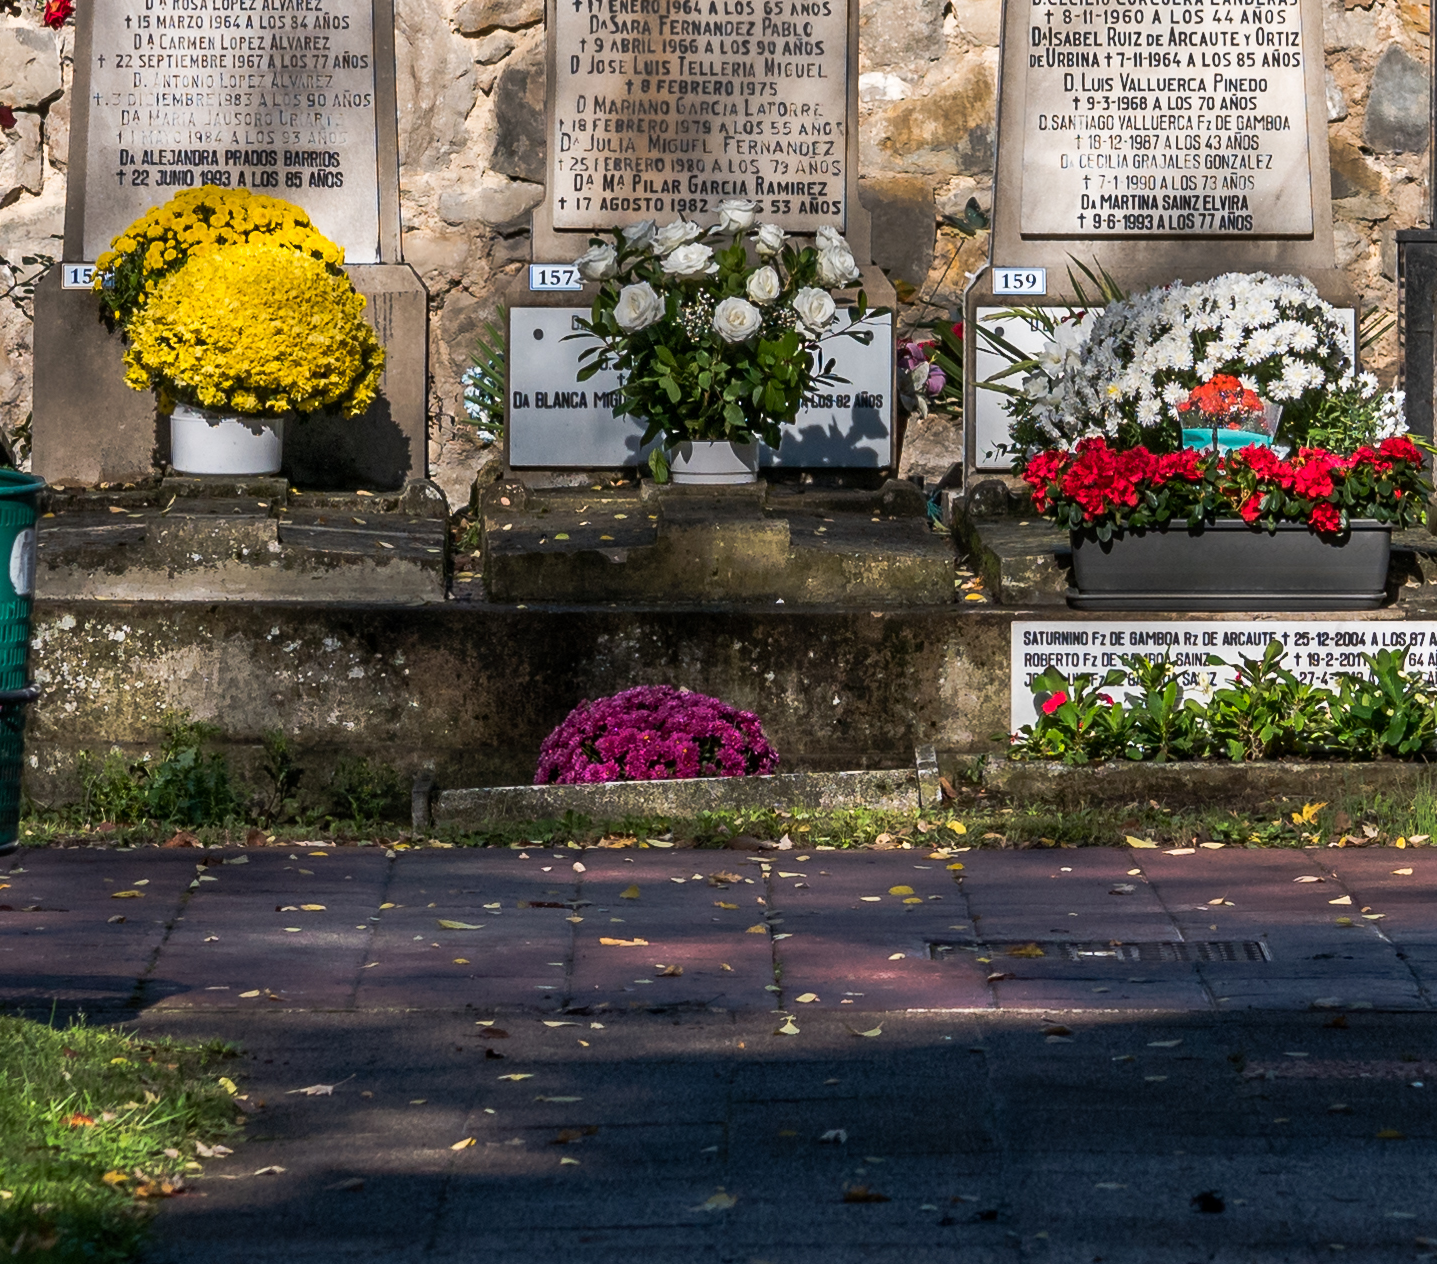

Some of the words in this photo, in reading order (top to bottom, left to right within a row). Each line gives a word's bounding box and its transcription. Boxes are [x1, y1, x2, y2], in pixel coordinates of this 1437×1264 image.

[138, 15, 150, 29] 15
[157, 15, 204, 29] MARZO
[210, 15, 241, 29] 1964
[260, 16, 286, 30] LOS
[291, 16, 308, 30] 84
[314, 16, 349, 30] AÑOS
[1171, 9, 1204, 24] LOS
[1213, 10, 1234, 24] 44
[1240, 6, 1286, 24] AÑOS
[610, 38, 656, 54] ABRIL
[662, 39, 698, 54] 1966
[720, 40, 750, 56] LOS
[757, 40, 776, 56] 90
[782, 38, 825, 56] AÑOS
[657, 80, 734, 97] FEBRERO
[740, 81, 778, 97] 1975
[142, 149, 219, 167] ALEJANDRA
[225, 150, 277, 167] PRADOS
[284, 151, 340, 168] BARRIOS
[1100, 194, 1159, 210] MARTINA
[1162, 195, 1200, 211] SAINZ
[1203, 195, 1248, 212] ELVIRA
[539, 270, 574, 286] 157
[1002, 274, 1037, 289] 159
[1024, 631, 1089, 646] SATURNINO
[1110, 632, 1125, 646] DE
[1129, 631, 1180, 647] GAMBOA
[1203, 632, 1218, 646] DE
[1222, 631, 1276, 647] ARCAUTE
[1382, 632, 1406, 647] LOS
[1409, 632, 1425, 647] 87
